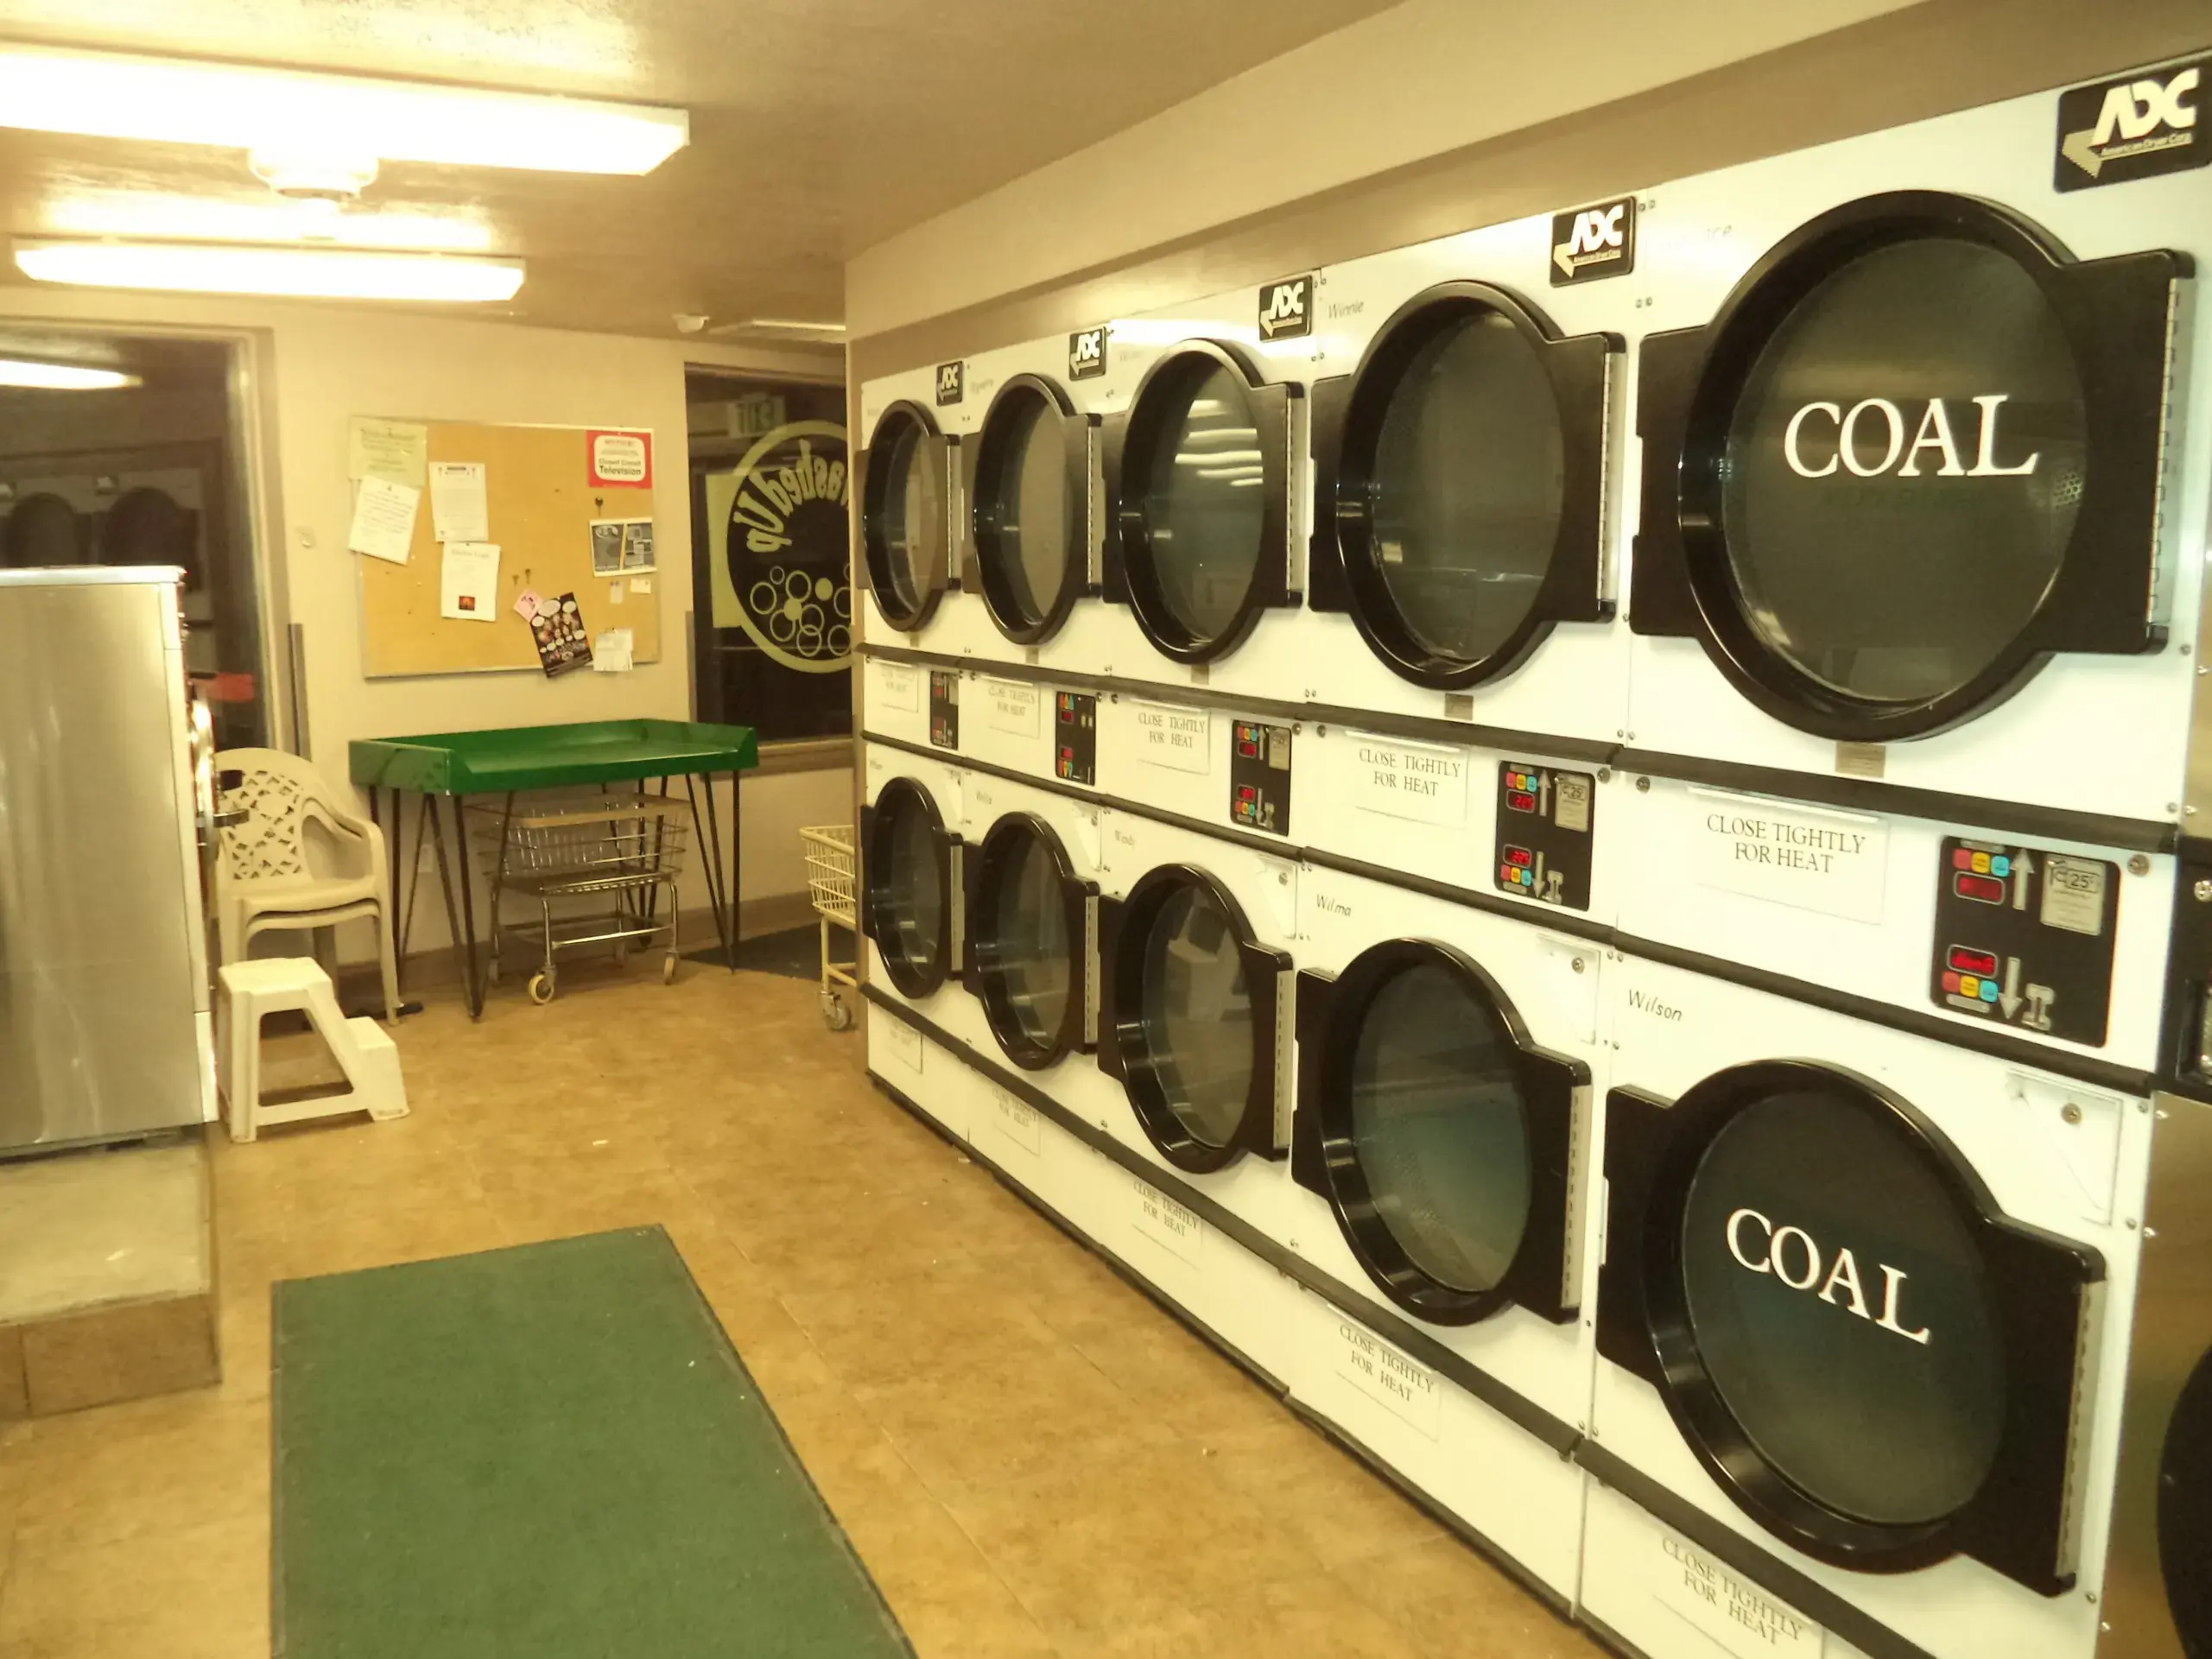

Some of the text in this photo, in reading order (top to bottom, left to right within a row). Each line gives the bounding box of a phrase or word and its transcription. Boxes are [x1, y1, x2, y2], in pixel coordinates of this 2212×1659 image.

[2090, 68, 2200, 146] ADC
[1570, 205, 1624, 256] ADC
[1269, 282, 1304, 320] ADC
[1076, 331, 1100, 362] ADC
[941, 364, 959, 390] ADC
[1784, 394, 2040, 478] COAL
[1138, 712, 1206, 734] CLOSE TIGHTLY
[1149, 731, 1192, 749] FOR HEAT
[1359, 748, 1461, 777] CLOSE TIGHTLY
[1373, 770, 1439, 796] FOR HEAT
[1707, 814, 1866, 854] CLOSE TIGHTLY
[1735, 842, 1834, 873] FOR HEAT
[1316, 893, 1352, 917] Wilma
[1629, 988, 1682, 1021] Wilson
[1163, 1213, 1186, 1237] HEAT
[1727, 1207, 1931, 1346] COAL
[1340, 1324, 1434, 1393] CLOSE TIGHTLY
[1351, 1350, 1413, 1402] FOR HEAT
[1662, 1536, 1802, 1641] CLOSE TIGHTLY
[1683, 1568, 1780, 1645] FOR HEAT
